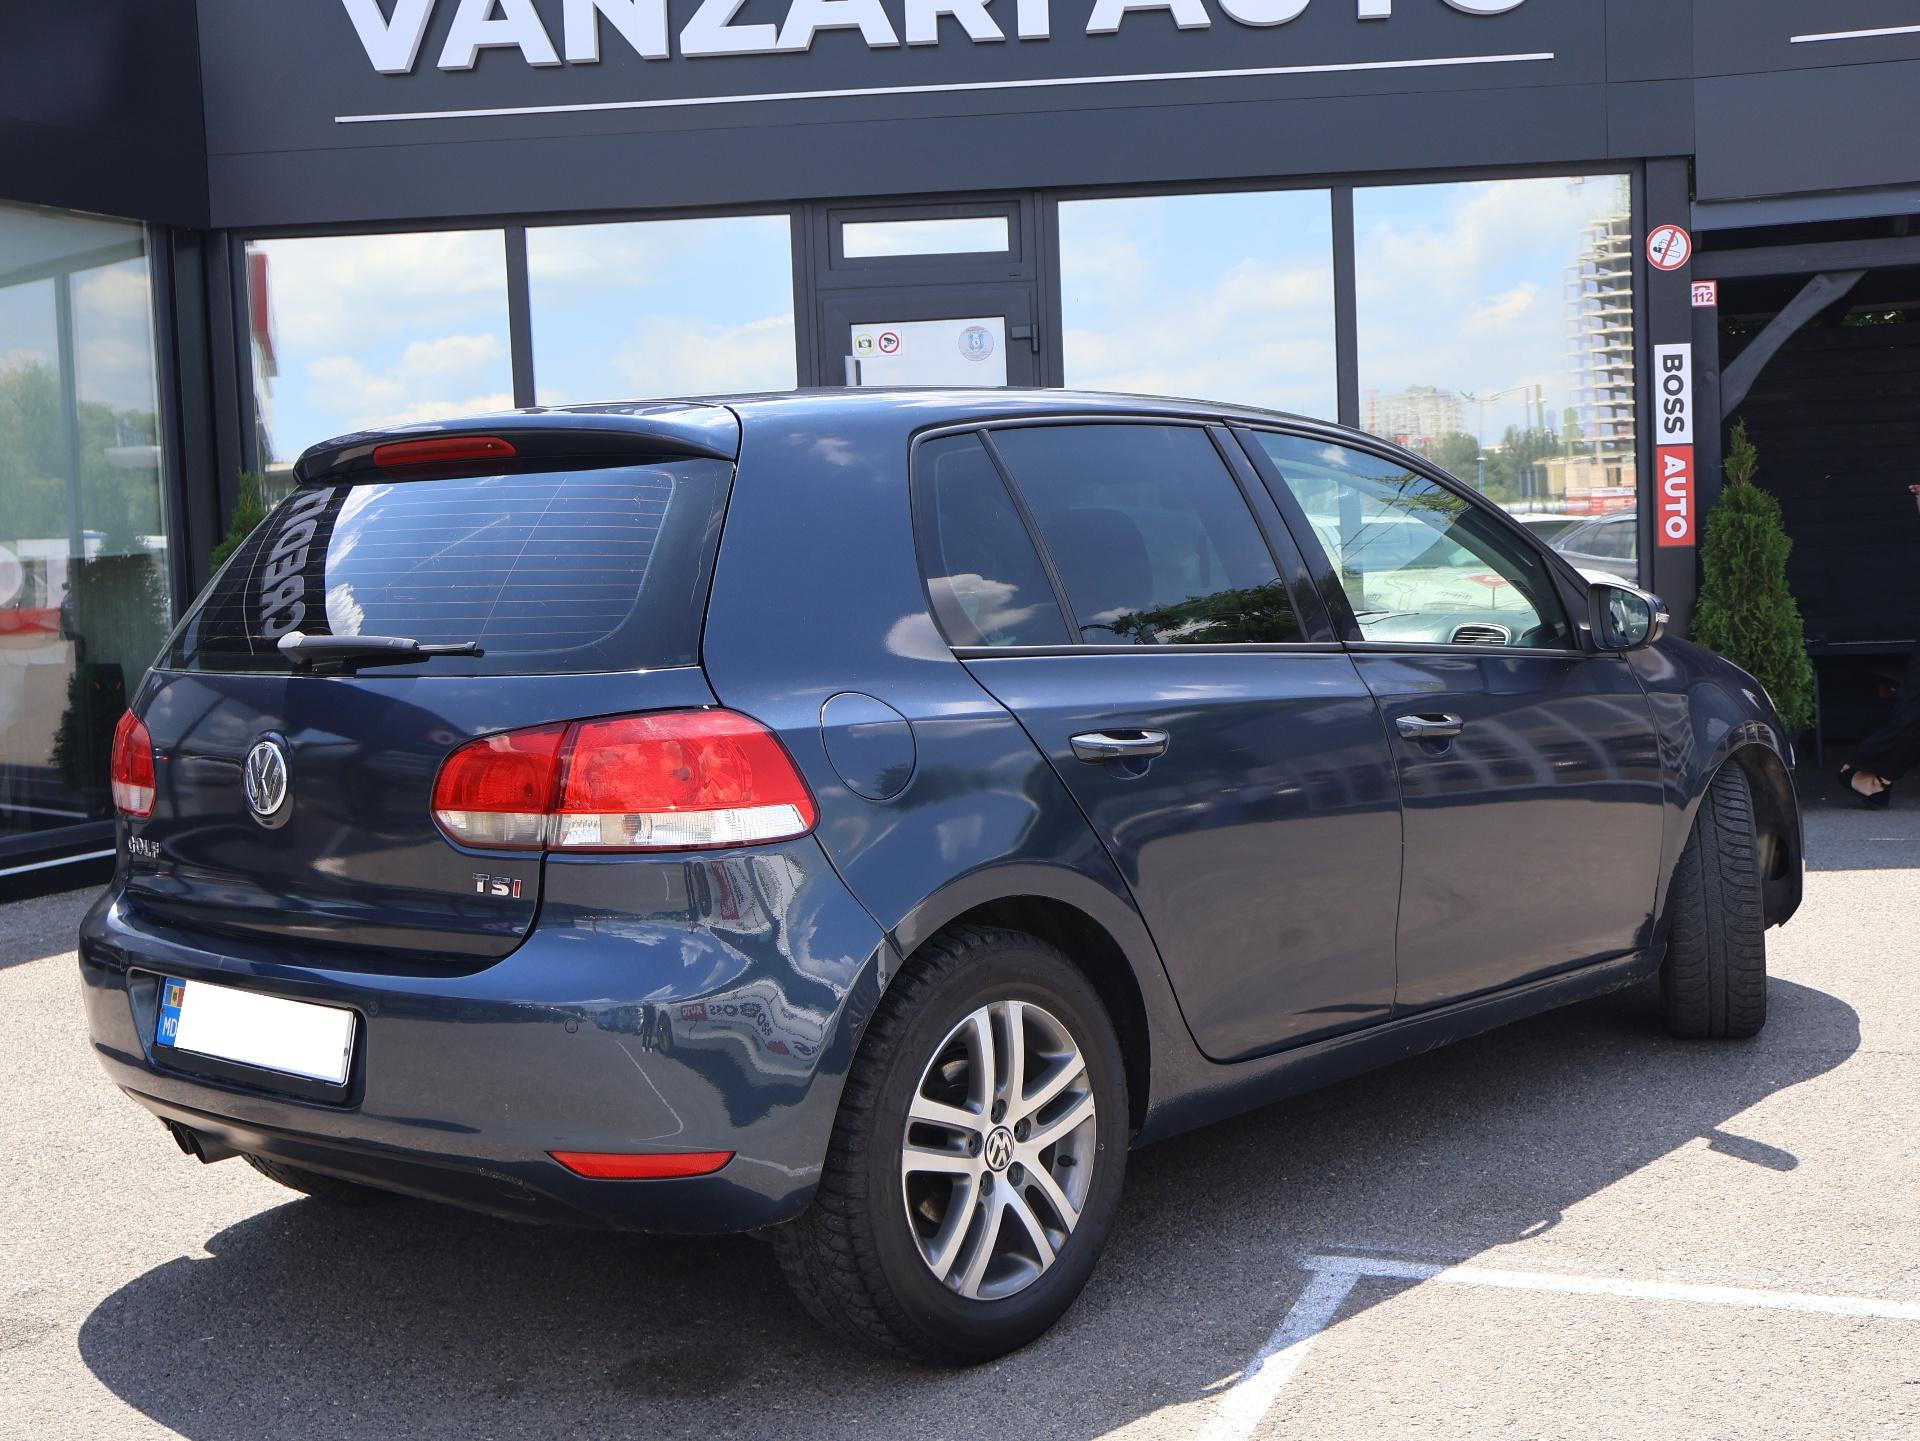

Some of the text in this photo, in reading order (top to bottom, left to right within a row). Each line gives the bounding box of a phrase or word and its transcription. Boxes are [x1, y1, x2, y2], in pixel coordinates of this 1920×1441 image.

[1692, 291, 1713, 303] 112
[1662, 353, 1688, 539] BOSS AUTO
[128, 836, 161, 859] GOLF
[472, 872, 522, 898] TSI
[162, 1016, 178, 1037] MD
